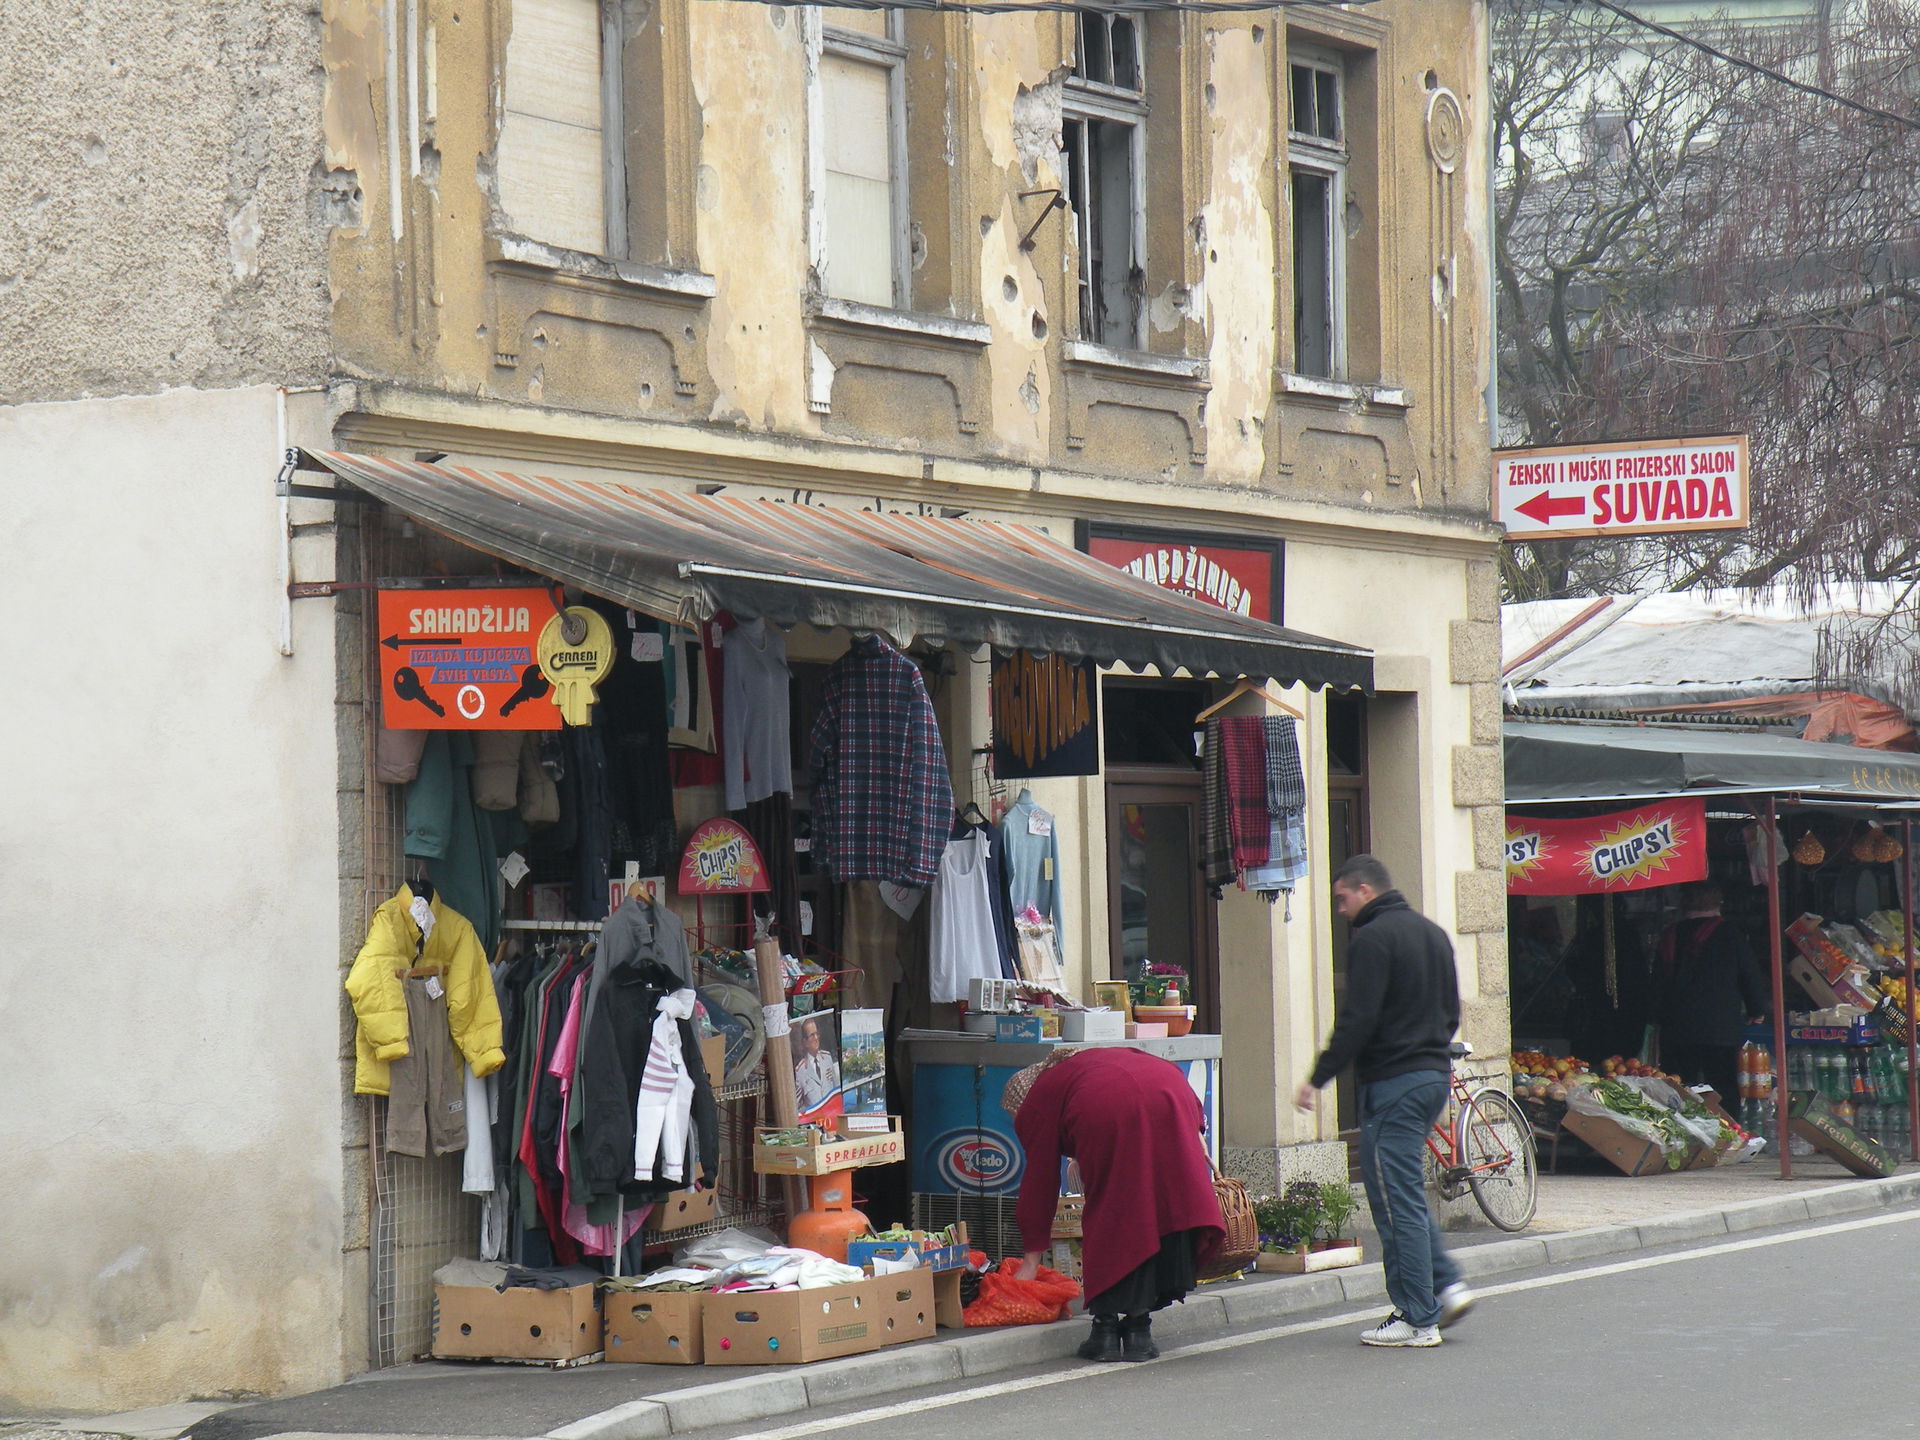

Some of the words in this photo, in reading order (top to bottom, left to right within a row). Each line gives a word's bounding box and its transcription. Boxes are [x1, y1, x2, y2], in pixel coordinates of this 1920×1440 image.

[1509, 462, 1555, 486] ŽENSKI
[1560, 462, 1564, 483] I
[1569, 457, 1611, 482] MUŠKI
[1616, 454, 1686, 479] FRIZERSKI
[1691, 451, 1735, 475] SALON
[1592, 476, 1733, 525] SUVADA
[409, 604, 530, 634] SAHADŽIJA
[412, 651, 460, 662] IZRADA
[438, 670, 468, 681] SVIH
[472, 669, 512, 680] VRSTA
[825, 1141, 897, 1163] SPREAFICO
[1816, 1116, 1848, 1144] Fresh
[1850, 1141, 1884, 1170] Fruits
